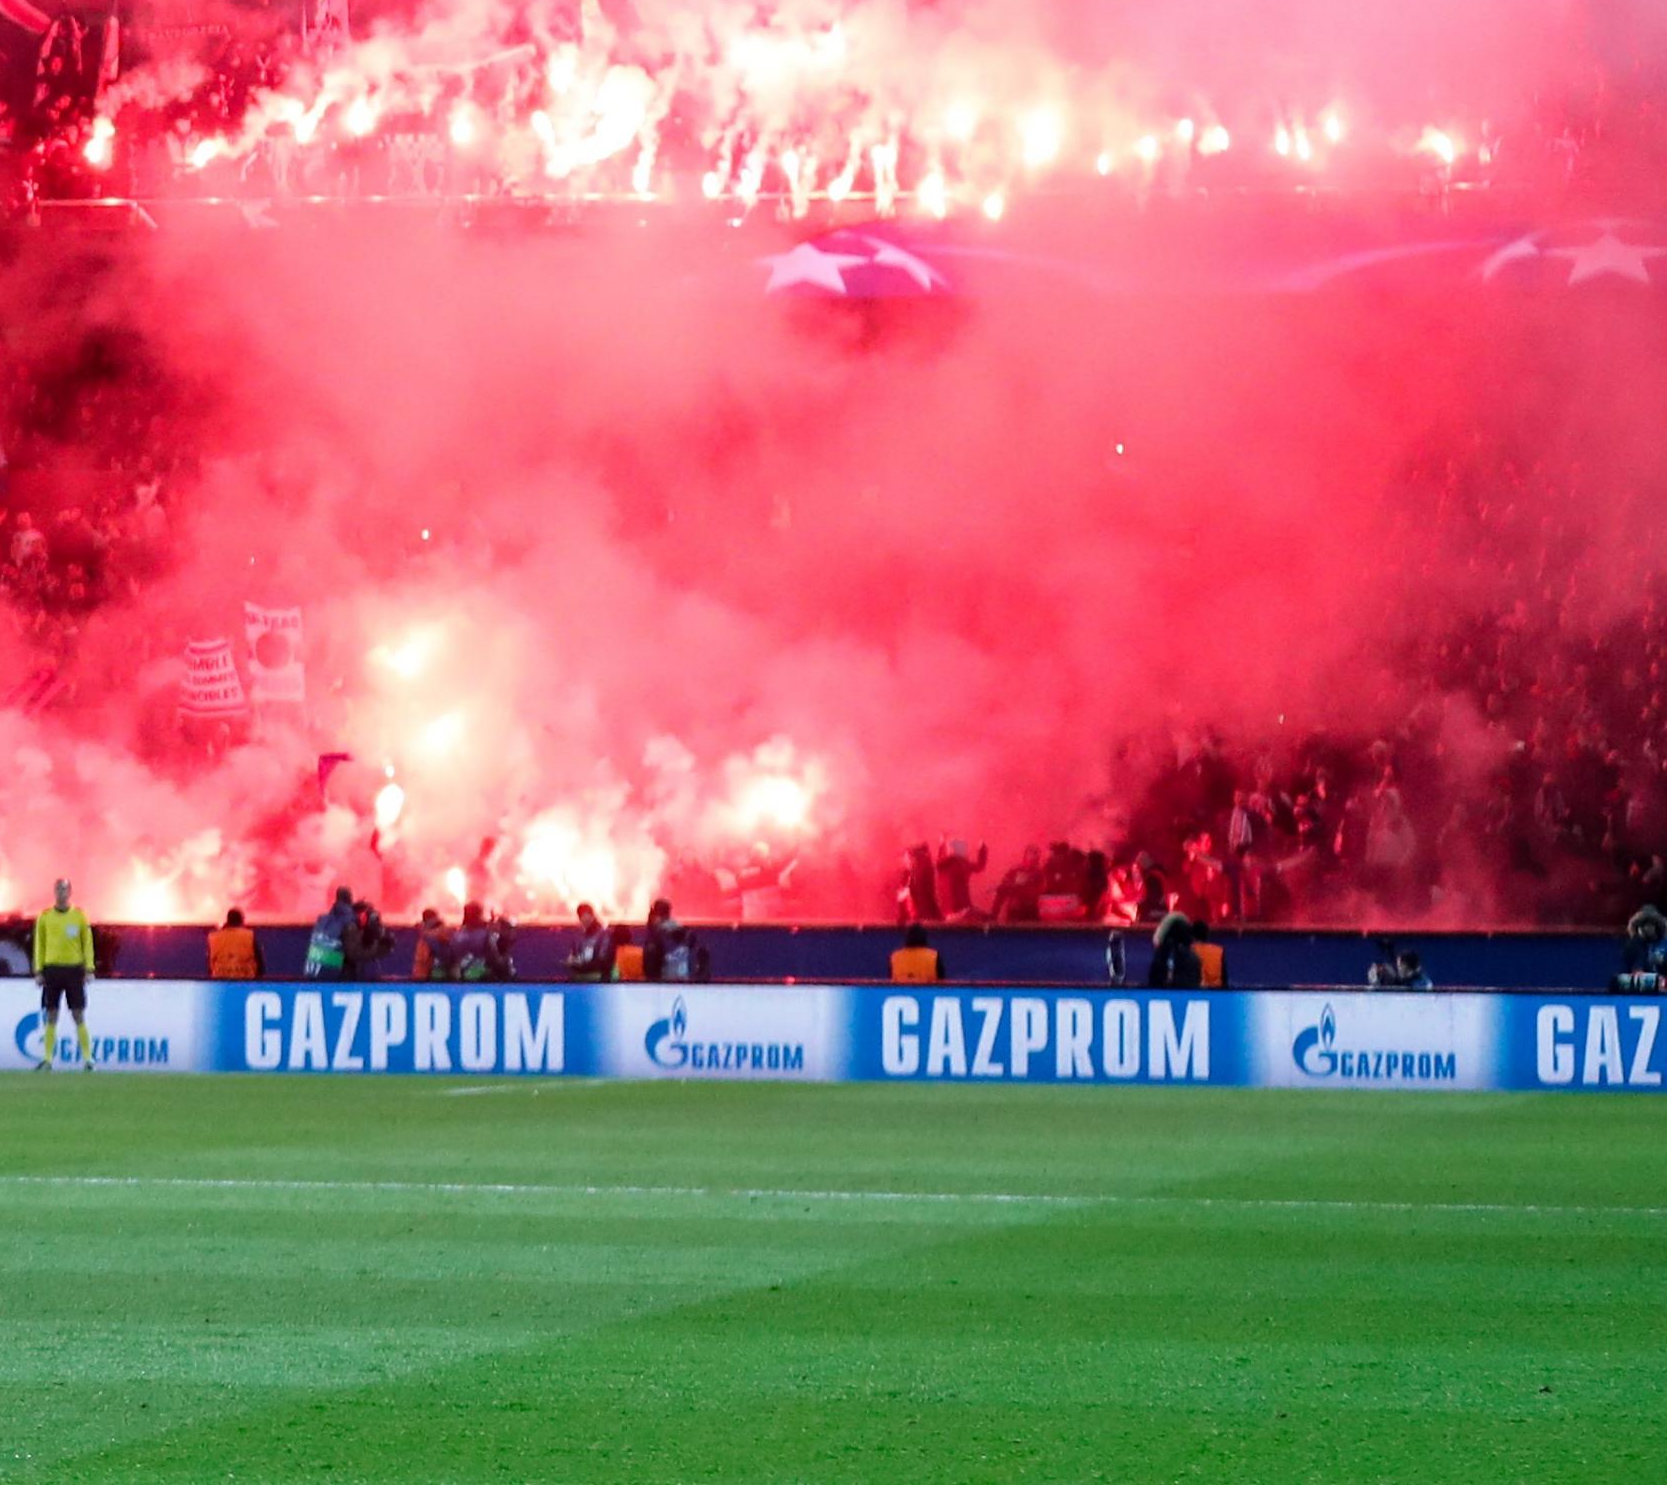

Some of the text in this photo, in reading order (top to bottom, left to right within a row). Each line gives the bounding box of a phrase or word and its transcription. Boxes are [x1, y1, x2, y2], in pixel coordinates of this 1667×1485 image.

[59, 1037, 169, 1063] GZPROM
[244, 991, 565, 1071] GAZPROM
[690, 1041, 803, 1070] GAZPROM
[882, 996, 1210, 1078] GAZPROM
[1537, 1004, 1661, 1085] GAZ
[1340, 1050, 1456, 1079] GAZPROM
